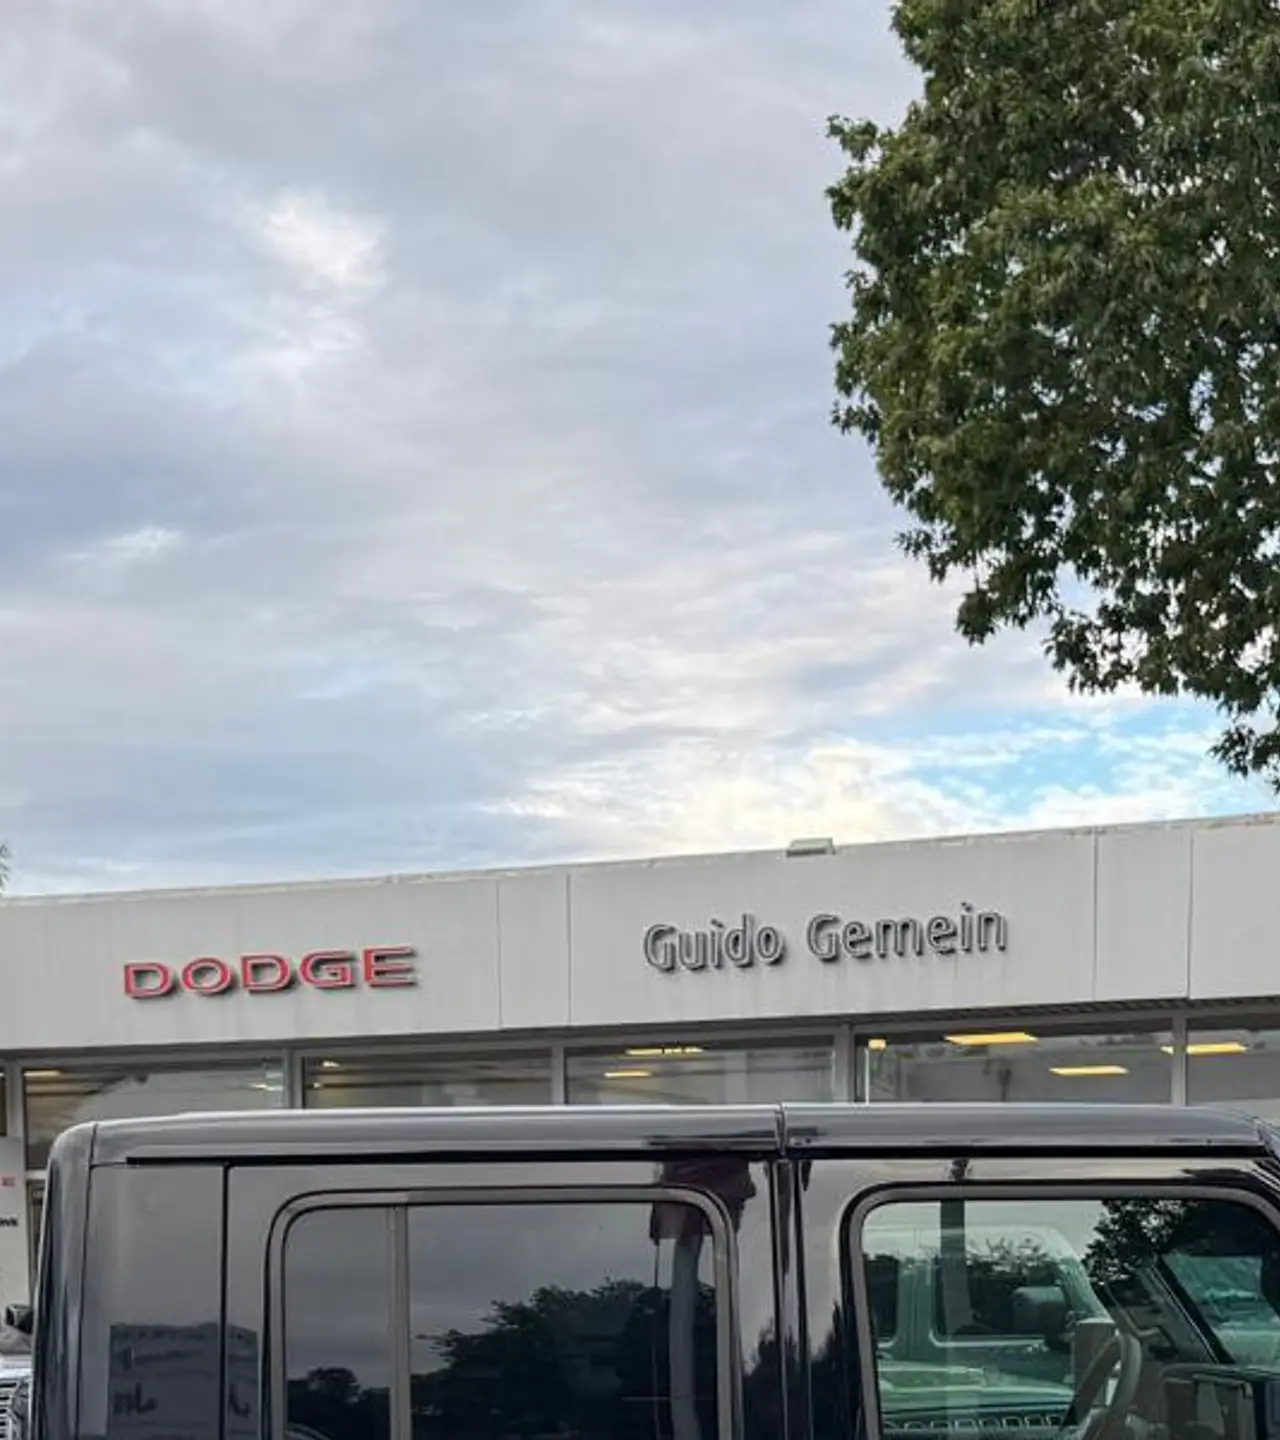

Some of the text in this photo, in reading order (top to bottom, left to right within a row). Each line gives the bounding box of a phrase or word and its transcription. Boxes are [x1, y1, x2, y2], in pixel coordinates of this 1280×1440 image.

[643, 902, 1007, 971] Guido Gemein
[123, 945, 418, 999] DODGE
